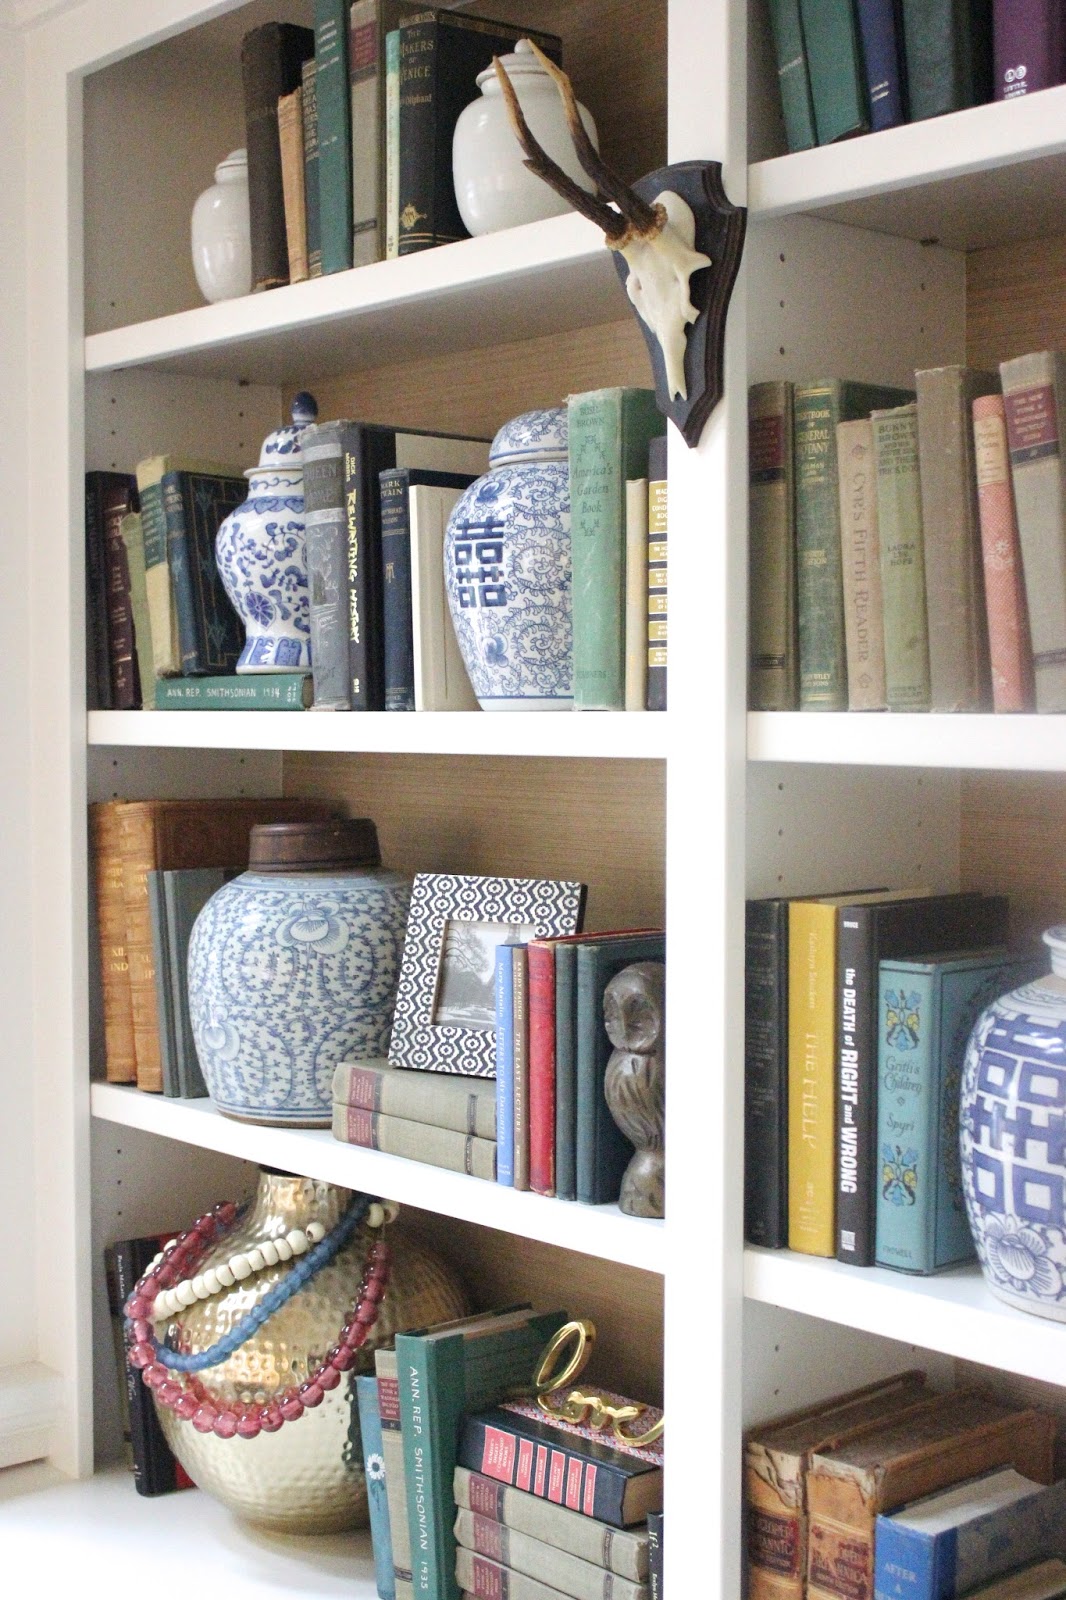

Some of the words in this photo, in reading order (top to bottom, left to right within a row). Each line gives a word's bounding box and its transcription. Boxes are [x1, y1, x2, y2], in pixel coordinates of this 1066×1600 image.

[577, 484, 609, 496] Garden
[582, 501, 602, 513] Book
[346, 488, 359, 583] REWRITING
[854, 529, 867, 582] FIFTH
[348, 588, 360, 644] HISTORY
[854, 590, 869, 663] READER
[166, 688, 183, 697] ANN.
[185, 687, 200, 697] REP.
[206, 687, 256, 698] SMITHSONIAN
[845, 968, 856, 986] the
[843, 988, 857, 1032] DEATH
[805, 1033, 817, 1071] THE
[844, 1035, 855, 1046] of
[841, 1049, 859, 1105] RIGHT
[802, 1078, 818, 1149] HELP
[844, 1105, 855, 1124] and
[841, 1126, 858, 1194] WRONG
[410, 1366, 420, 1402] ANN.
[412, 1406, 423, 1437] REP.
[414, 1448, 428, 1550] SMITHSONIAN
[420, 1561, 429, 1589] 1935
[884, 1562, 917, 1583] AFTER
